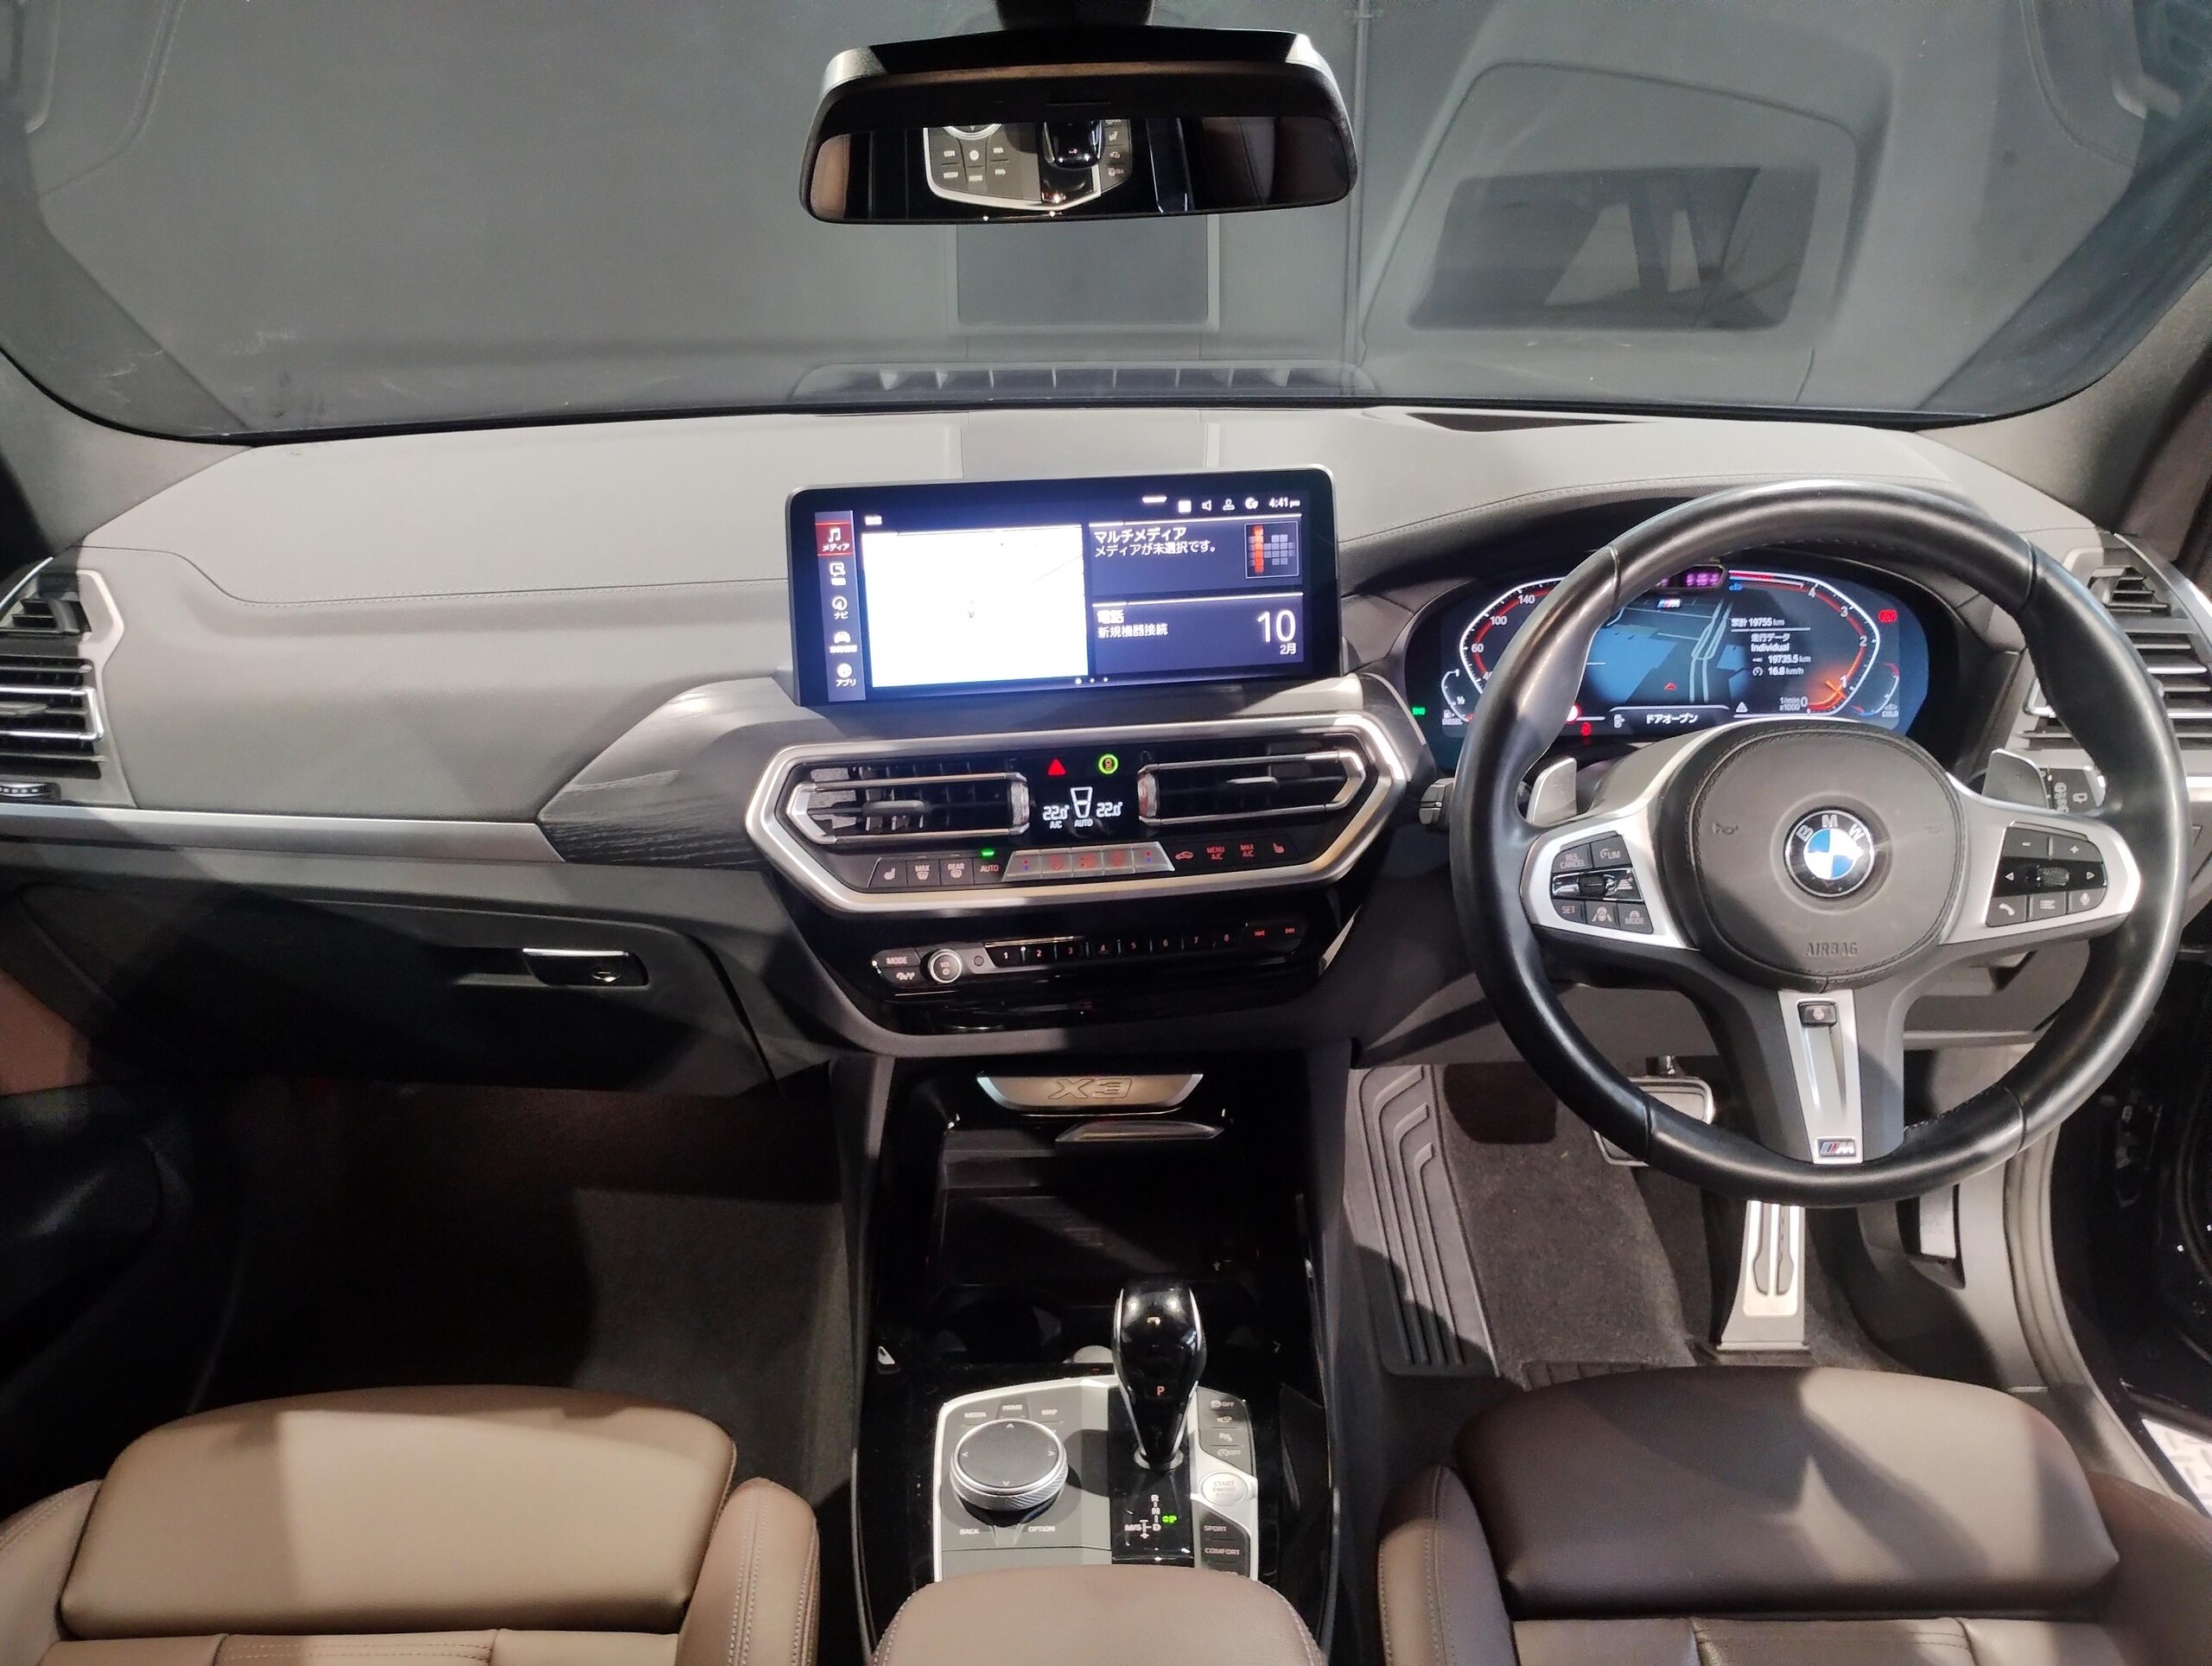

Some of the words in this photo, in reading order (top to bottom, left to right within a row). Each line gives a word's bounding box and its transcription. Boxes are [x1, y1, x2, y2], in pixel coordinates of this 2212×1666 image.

[1268, 497, 1288, 508] 4:41
[1094, 526, 1187, 544] マルチメディア
[822, 543, 850, 552] メディア
[1808, 587, 1816, 598] 4
[1517, 594, 1535, 605] 140
[833, 611, 849, 620] ナビ
[1840, 606, 1848, 618] 3
[1491, 615, 1508, 626] 100
[1749, 617, 1773, 627] 19755
[1097, 623, 1169, 639] 新規機器接続
[1257, 609, 1297, 643] 10
[1859, 635, 1868, 647] 2
[1280, 642, 1297, 655] 2月
[1471, 643, 1484, 653] 60
[1751, 643, 1790, 652] Individual
[1768, 666, 1785, 676] 16.8
[836, 678, 857, 688] アプリ
[1840, 675, 1847, 688] 1
[1800, 696, 1808, 708] 0
[1646, 711, 1699, 725] ドアオープン
[1074, 818, 1094, 828] AUTO
[1796, 814, 1866, 843] BMW
[1565, 852, 1579, 862] RES
[947, 862, 965, 871] REAR
[980, 864, 1000, 873] AUTO
[1561, 905, 1576, 914] SET
[1163, 938, 1169, 947] 6
[1194, 936, 1199, 944] 7
[1068, 946, 1073, 955] 3
[1131, 941, 1136, 950] 5
[1806, 941, 1859, 957] AIRBAG
[1037, 949, 1042, 957] 2
[886, 956, 908, 965] MODE
[1047, 1078, 1133, 1100] X3
[1157, 1386, 1166, 1396] P
[1152, 1523, 1162, 1532] D
[1204, 1547, 1241, 1555] COMFORT
